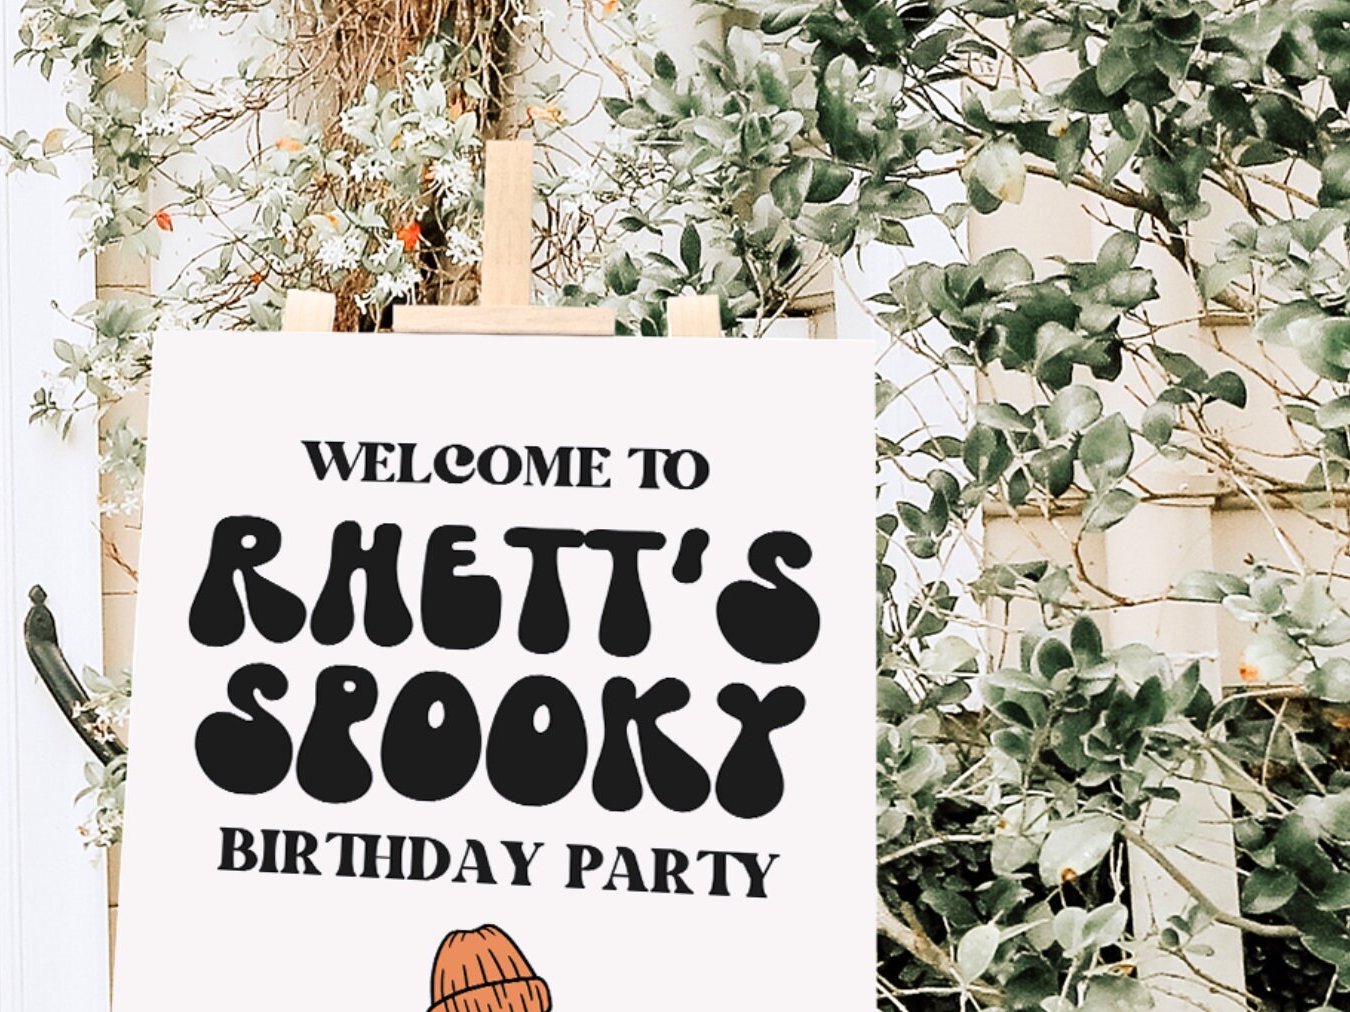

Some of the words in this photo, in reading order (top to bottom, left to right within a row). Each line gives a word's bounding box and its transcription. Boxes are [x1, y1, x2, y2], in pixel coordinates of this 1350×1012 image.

[301, 440, 611, 488] WELCOME
[627, 448, 710, 490] TO
[188, 515, 821, 665] RHETT'S
[194, 662, 806, 820] SPOOKY
[217, 827, 545, 887] BIRTHDAY
[565, 843, 780, 899] PARTY
